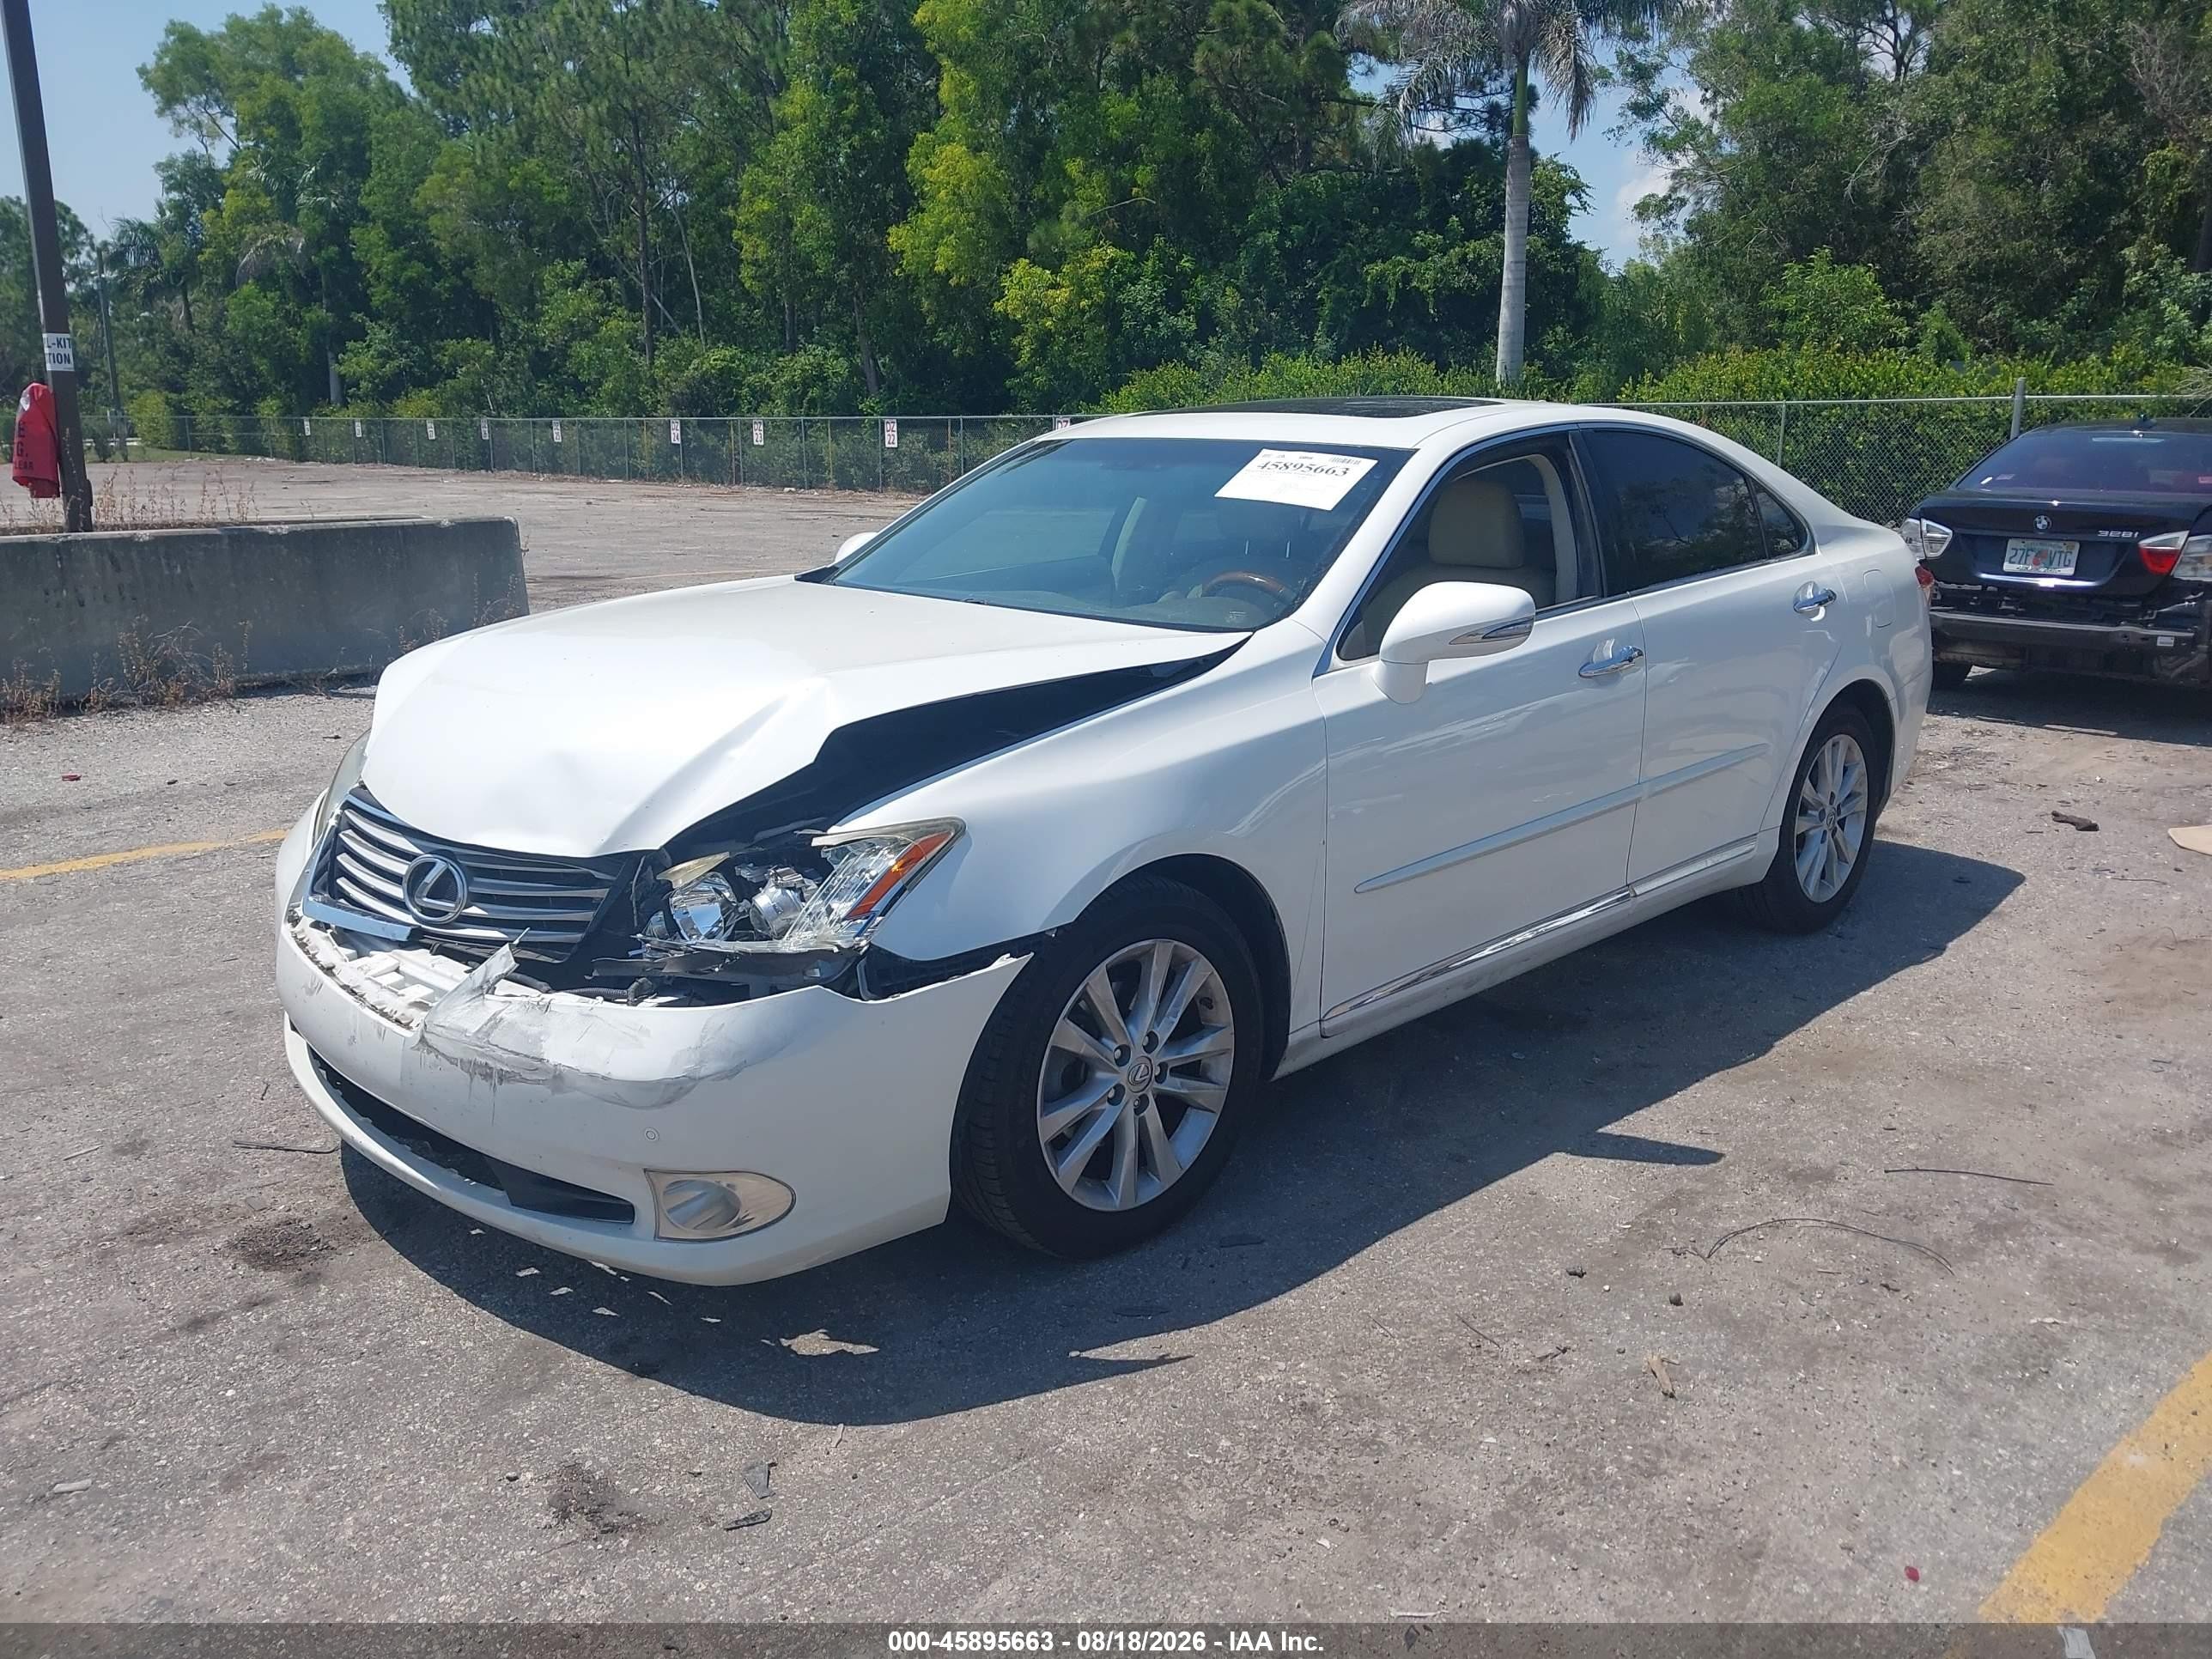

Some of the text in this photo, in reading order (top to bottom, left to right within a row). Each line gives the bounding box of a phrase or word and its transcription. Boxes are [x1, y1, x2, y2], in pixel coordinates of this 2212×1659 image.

[672, 421, 679, 431] DZ
[753, 421, 763, 432] DZ
[885, 421, 896, 432] DZ
[886, 434, 896, 445] 22
[1256, 461, 1351, 477] 45895663
